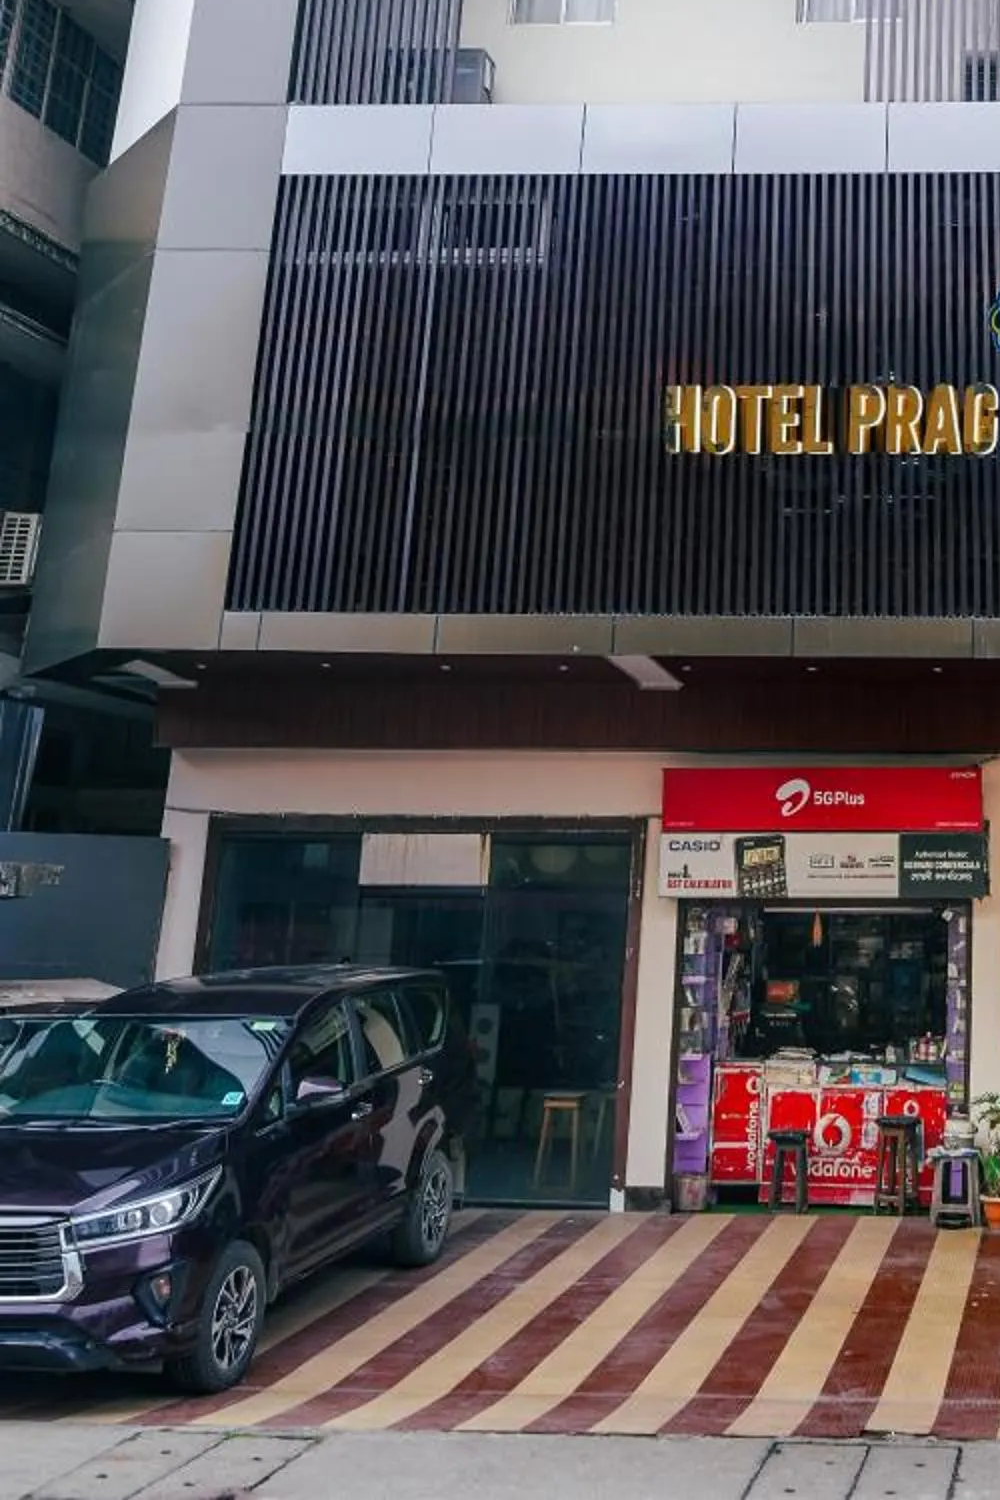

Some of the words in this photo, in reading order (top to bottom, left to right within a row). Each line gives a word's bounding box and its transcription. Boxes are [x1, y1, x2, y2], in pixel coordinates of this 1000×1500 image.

[665, 384, 833, 455] HOTEL
[846, 383, 999, 455] PRAG
[834, 790, 865, 805] Plus
[669, 840, 720, 851] CASIO
[745, 1099, 758, 1172] vodafone
